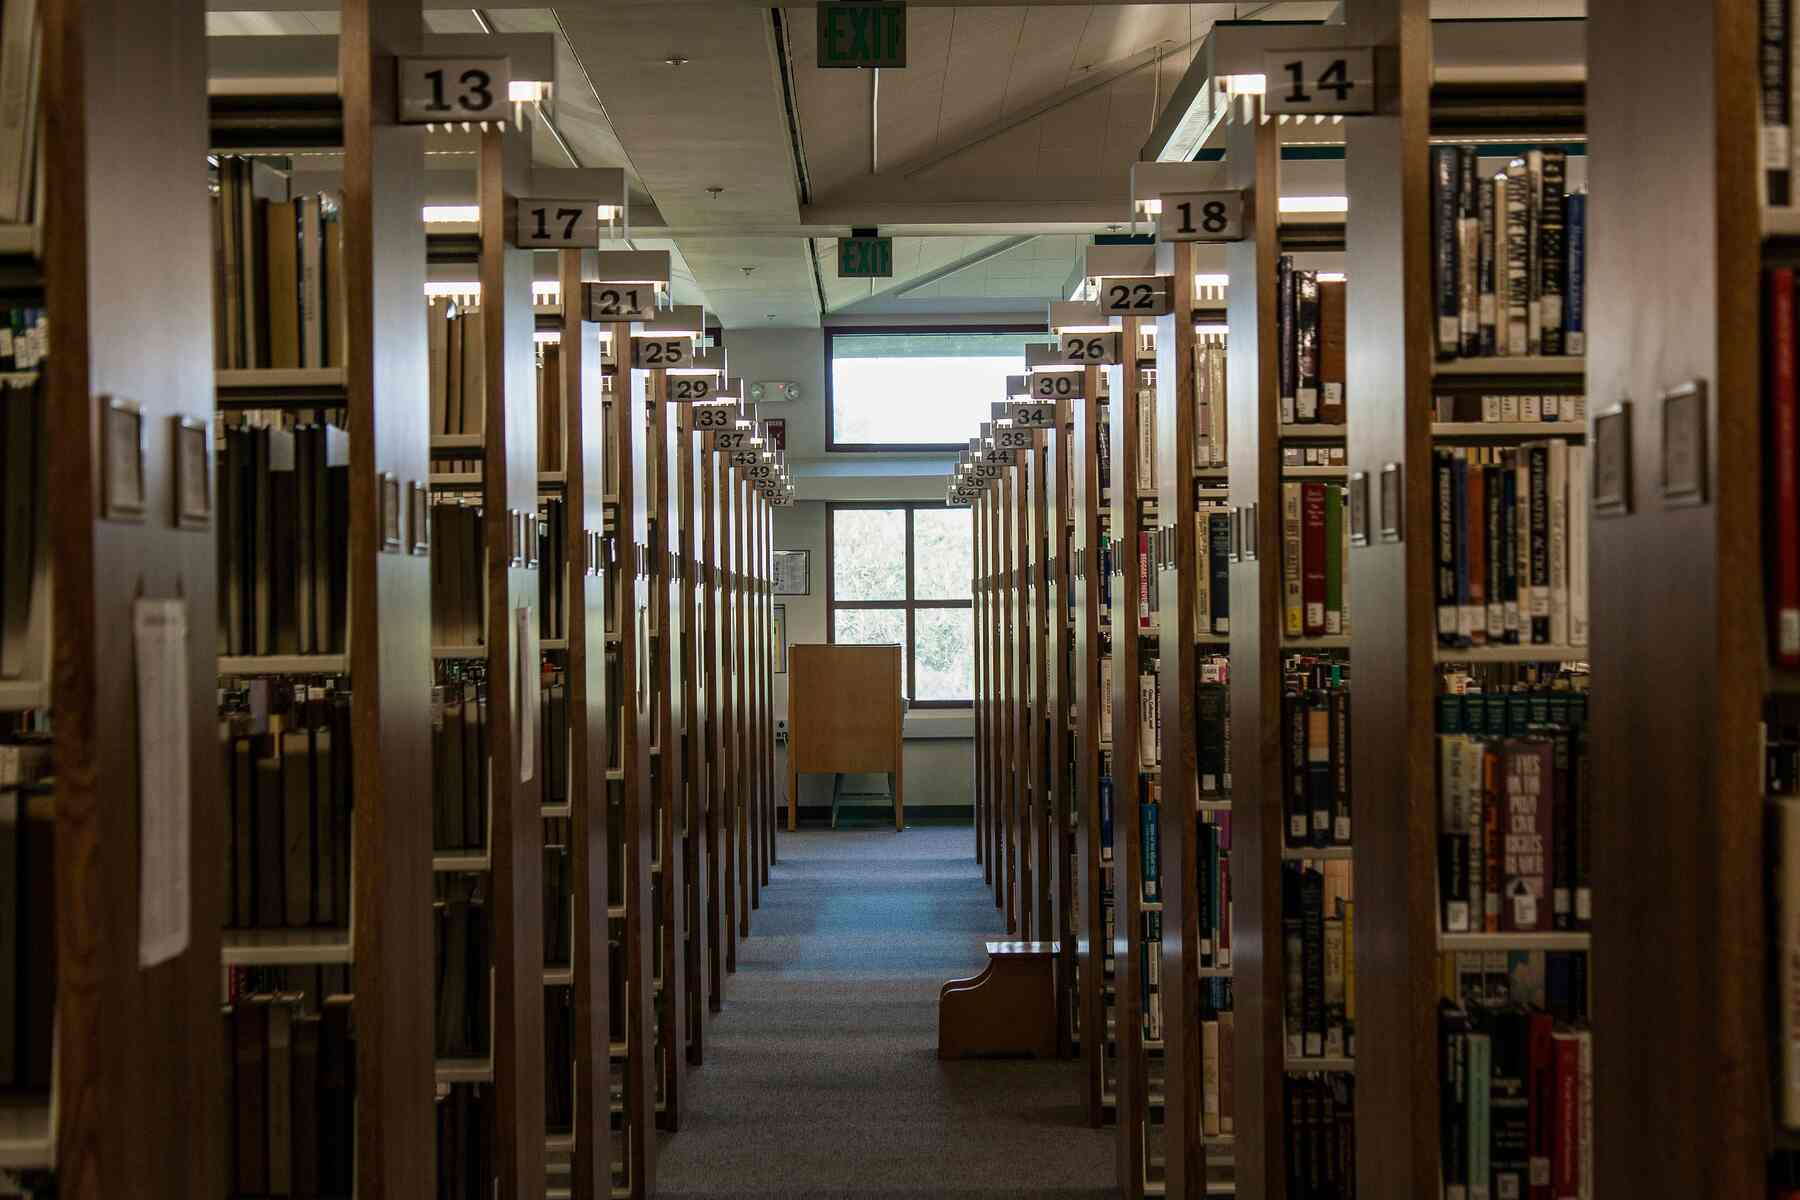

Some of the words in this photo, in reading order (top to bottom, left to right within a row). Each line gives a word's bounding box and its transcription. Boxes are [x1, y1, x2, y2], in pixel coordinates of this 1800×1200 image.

[828, 7, 901, 58] EXIT
[423, 68, 493, 112] 13
[1284, 59, 1355, 103] 14
[530, 207, 583, 240] 17
[1176, 200, 1228, 234] 18
[844, 240, 889, 273] EXIT
[600, 290, 642, 315] 21
[1110, 283, 1154, 310] 22
[645, 341, 682, 363] 25
[1067, 338, 1104, 360] 26
[677, 380, 708, 399] 29
[1040, 377, 1071, 395] 30
[700, 410, 727, 426] 33
[1018, 408, 1045, 425] 34
[720, 434, 744, 448] 37
[1001, 432, 1025, 447] 38
[735, 452, 757, 464] 43
[986, 450, 1008, 463] 44
[750, 466, 769, 478] 49
[976, 465, 996, 477] 50
[967, 476, 984, 487] 56
